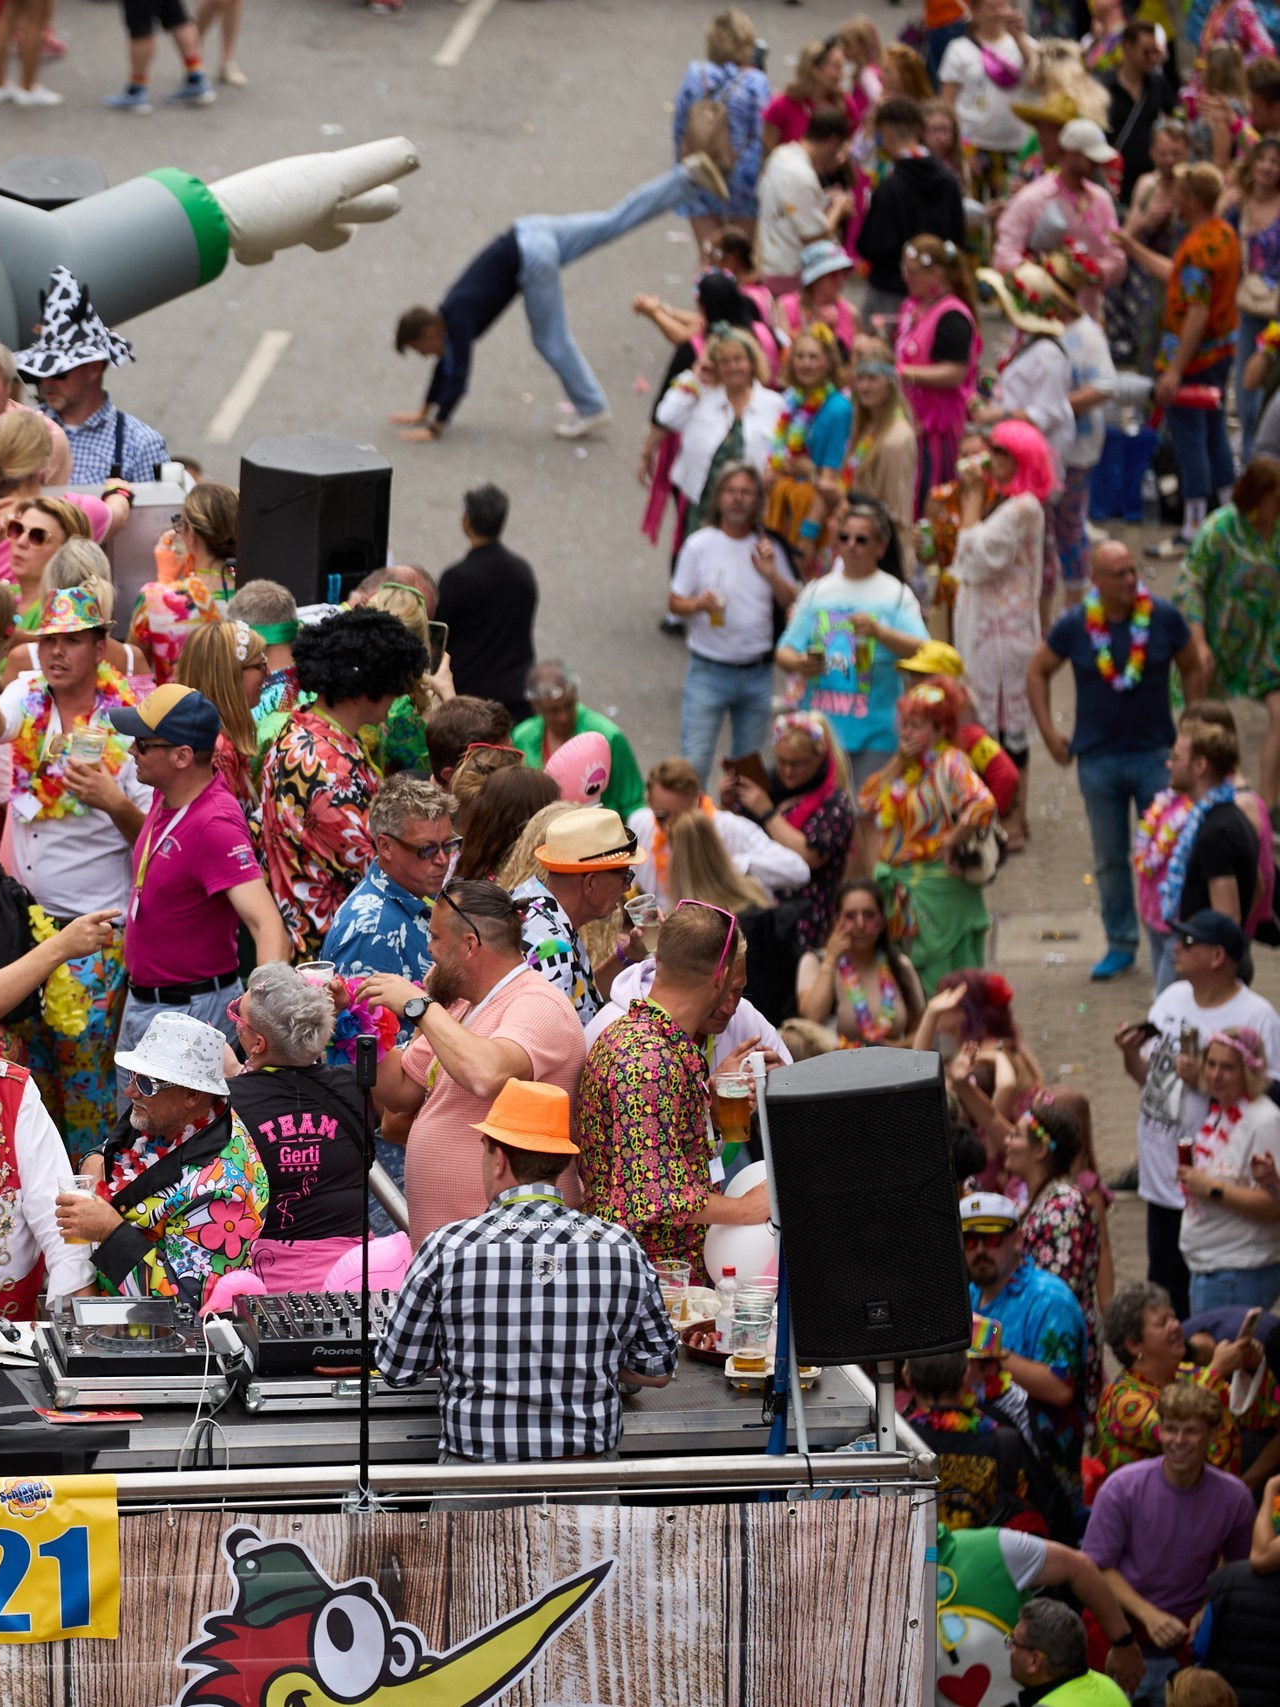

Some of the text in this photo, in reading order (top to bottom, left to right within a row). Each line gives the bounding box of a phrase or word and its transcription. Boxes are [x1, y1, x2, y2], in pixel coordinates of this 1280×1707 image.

[258, 1113, 338, 1143] TEAM
[280, 1145, 320, 1163] Gerti
[312, 1346, 362, 1356] Pionee
[0, 1482, 43, 1503] Schlager
